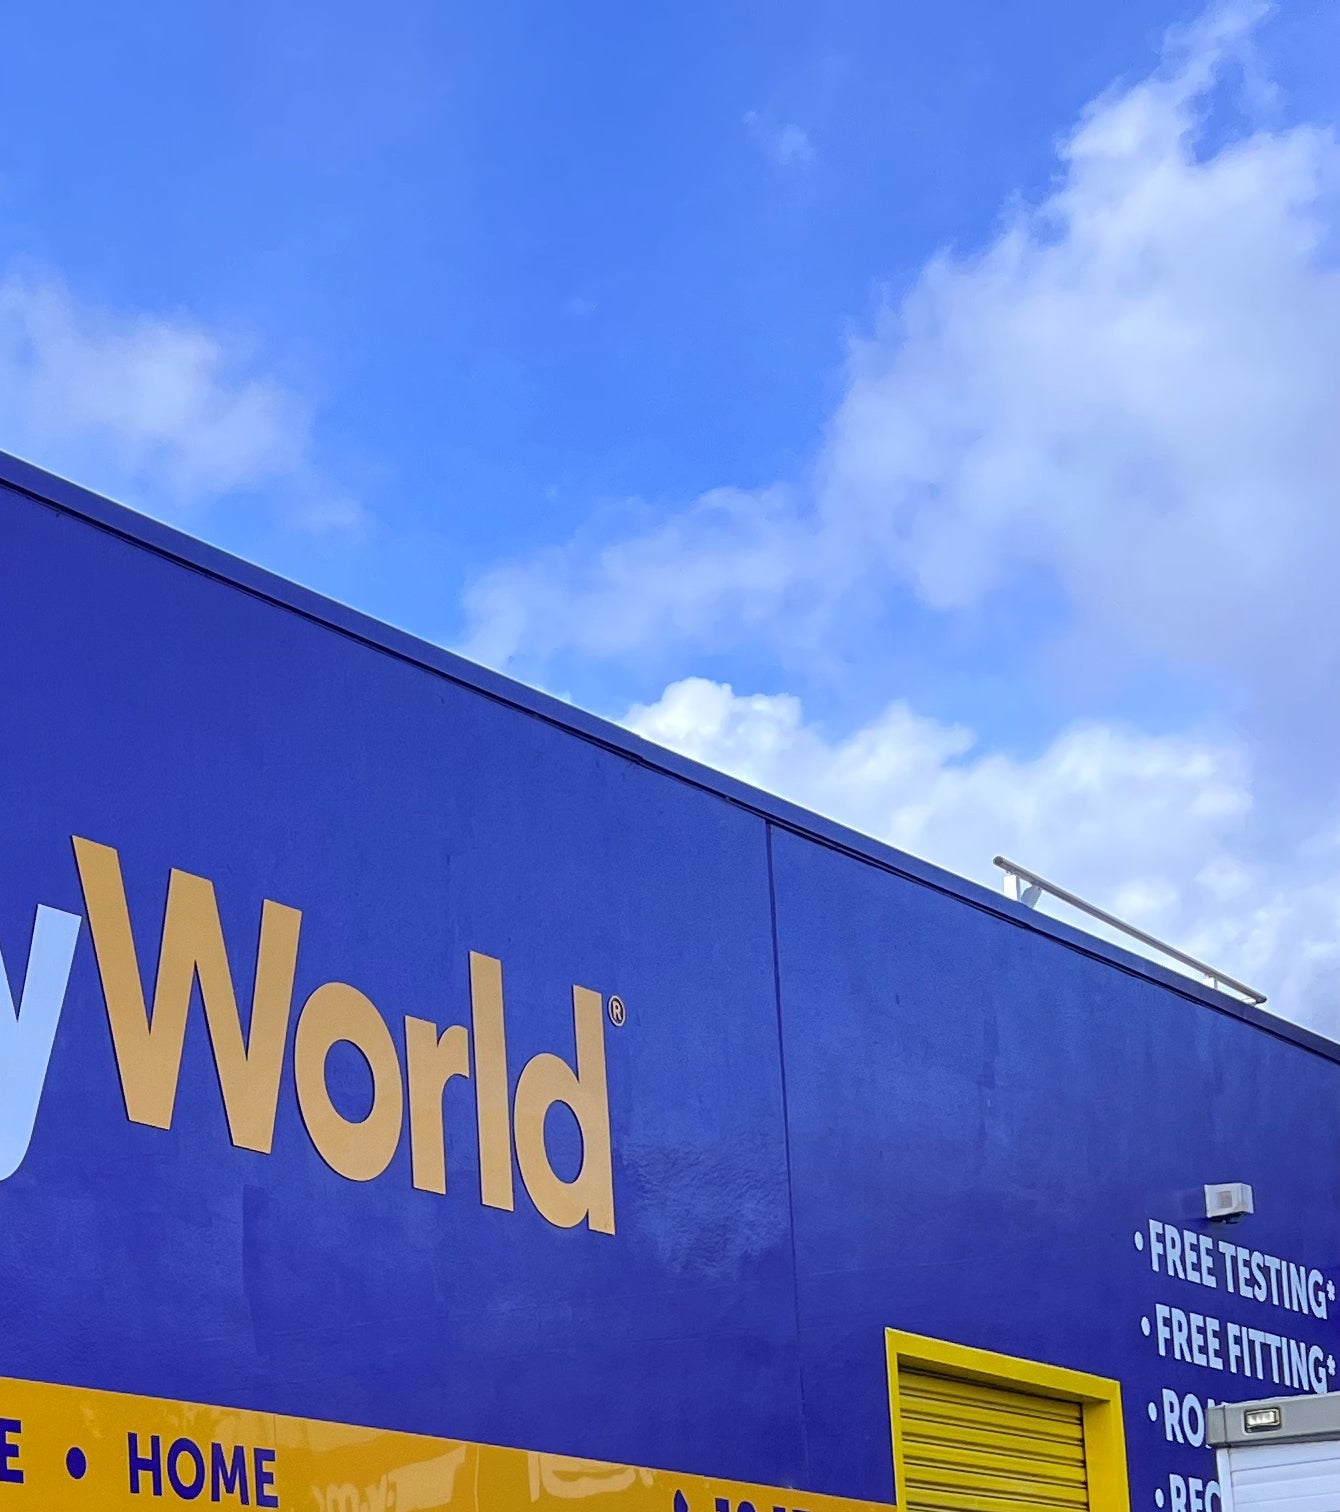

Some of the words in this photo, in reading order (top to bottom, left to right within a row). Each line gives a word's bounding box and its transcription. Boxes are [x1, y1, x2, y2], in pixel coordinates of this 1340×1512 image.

[1148, 1218, 1217, 1289] FREE
[1155, 1303, 1224, 1371] FREE
[127, 1430, 279, 1509] HOME
